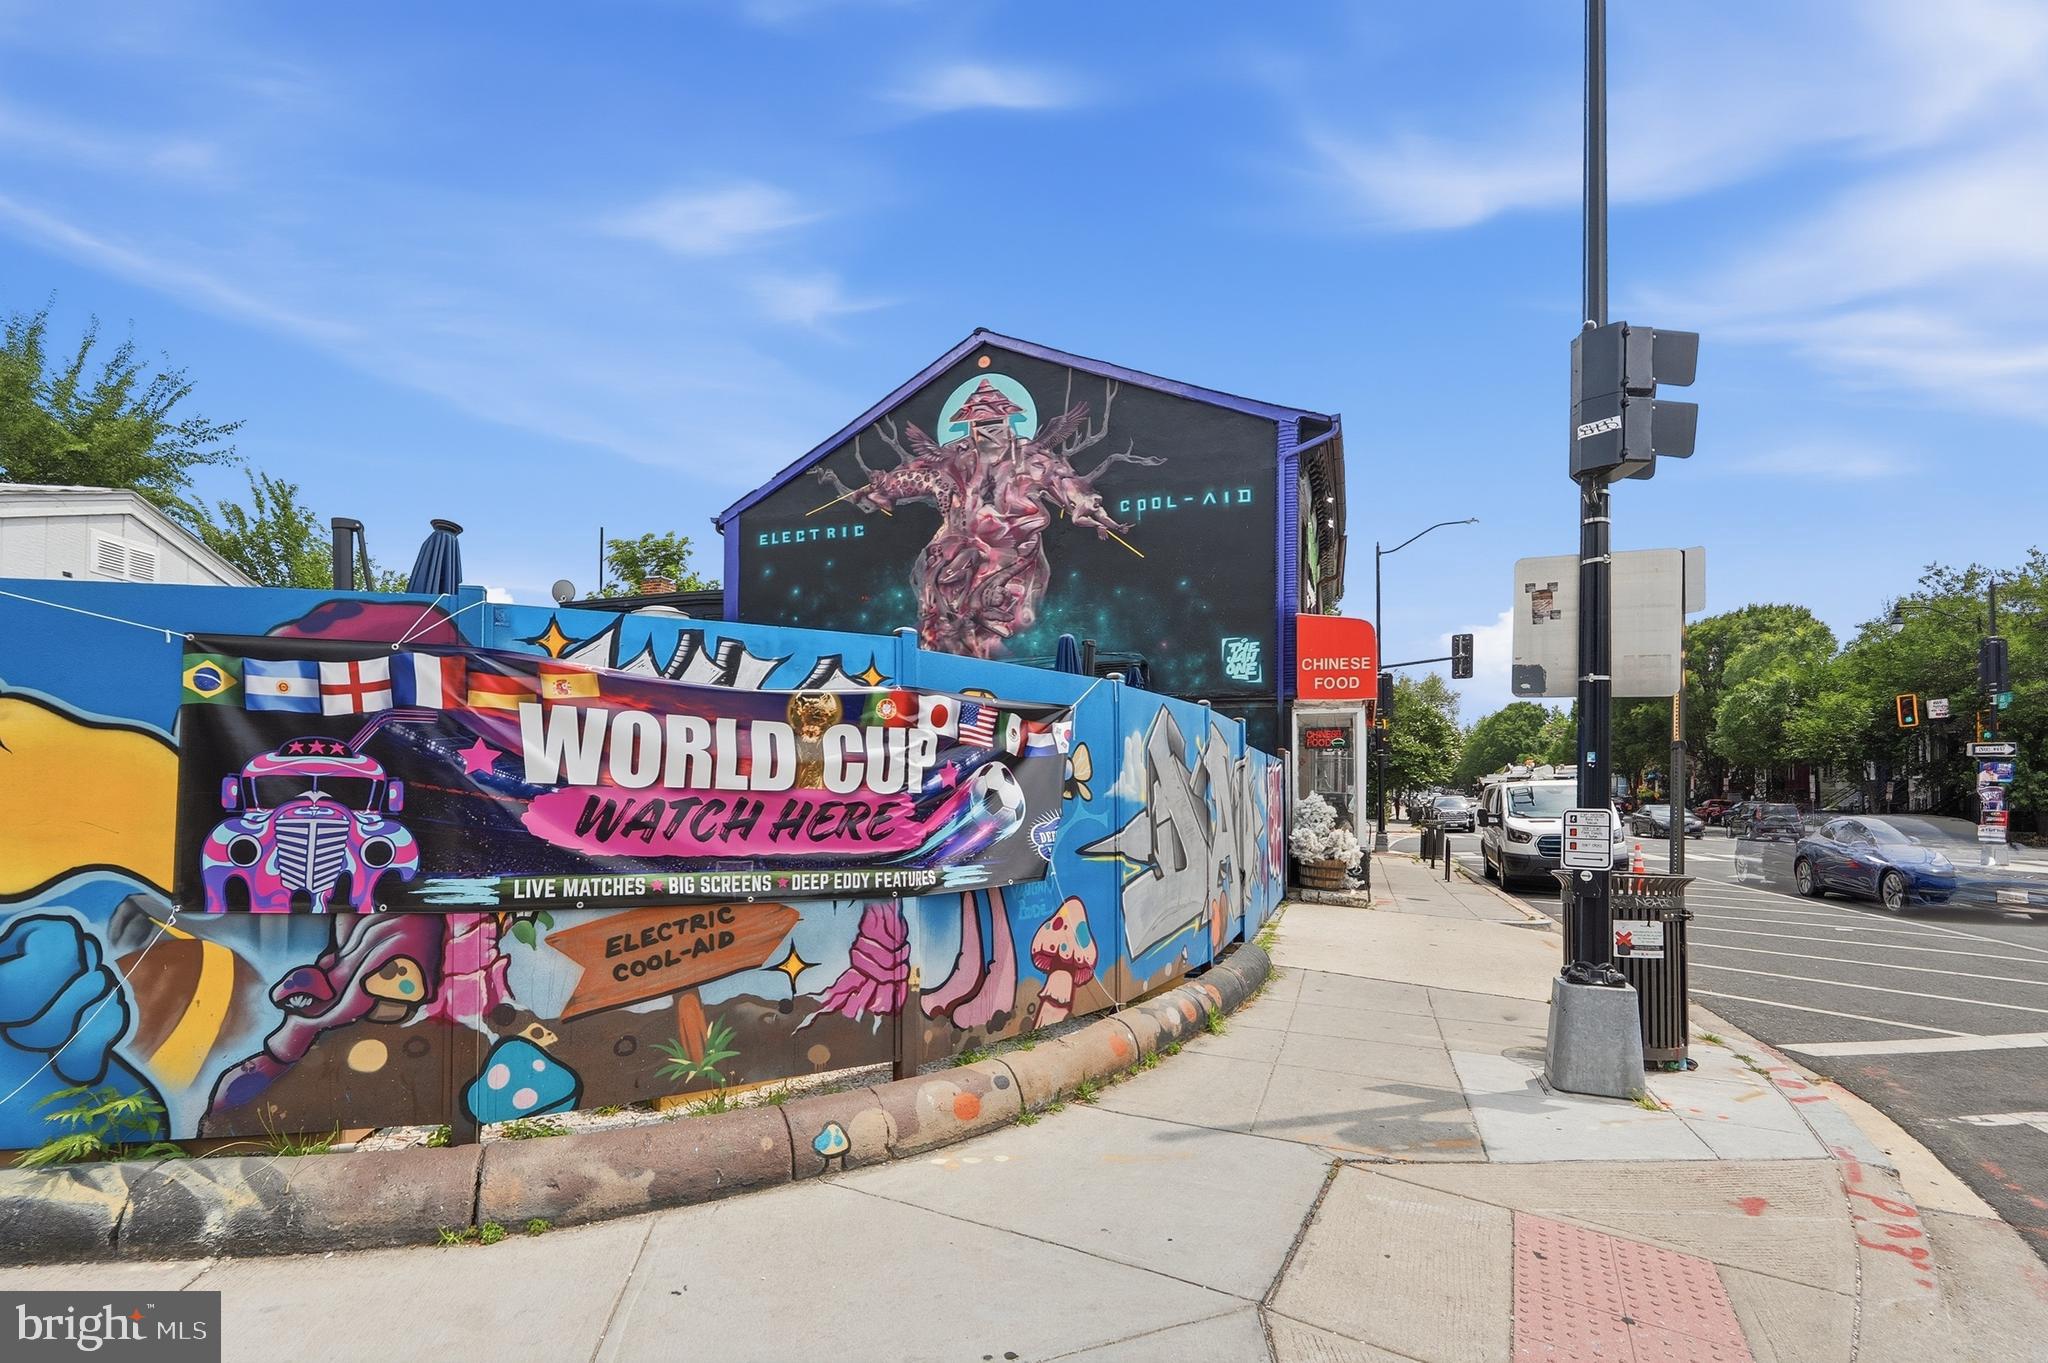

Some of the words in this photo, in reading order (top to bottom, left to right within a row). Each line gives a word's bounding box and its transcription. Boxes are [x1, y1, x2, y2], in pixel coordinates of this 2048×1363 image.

[1120, 489, 1251, 512] COOL-AID
[759, 525, 864, 546] ELECTRIC
[1302, 657, 1371, 670] CHINESE
[1314, 677, 1360, 690] FOOD
[518, 702, 796, 791] WORLD
[823, 723, 938, 794] CUP
[575, 796, 764, 843] WATCH
[770, 799, 898, 843] HERE
[513, 879, 556, 899] LIVE
[563, 877, 646, 897] MATCHES
[668, 876, 695, 894] BIG
[701, 875, 772, 893] SCREENS
[792, 873, 829, 891] DEEP
[834, 872, 869, 889] EDDY
[875, 869, 936, 888] FEATURES
[605, 906, 735, 959] ELECTRIC
[612, 931, 735, 981] COOL-AID
